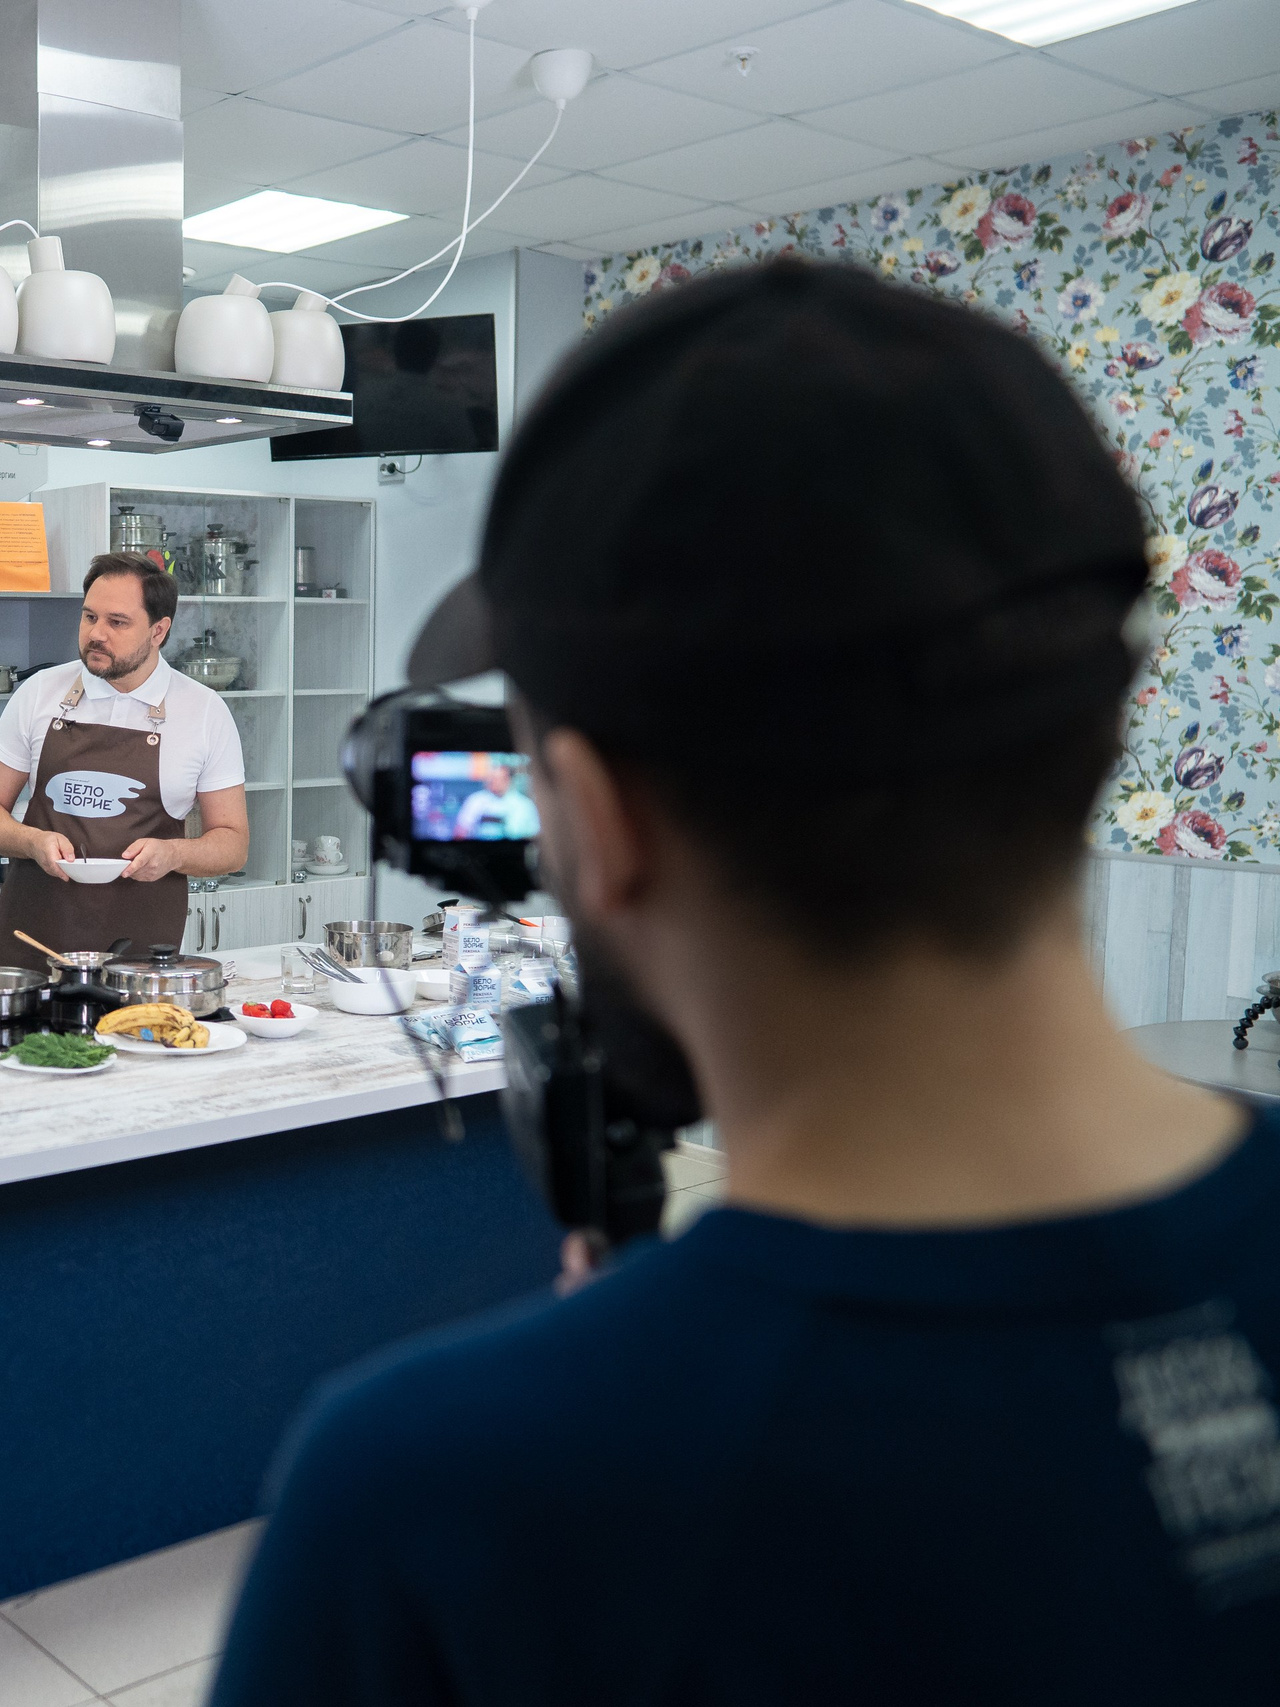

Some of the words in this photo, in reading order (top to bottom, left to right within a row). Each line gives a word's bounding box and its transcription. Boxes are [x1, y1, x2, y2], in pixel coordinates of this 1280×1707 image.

[63, 782, 104, 798] БЕЛО
[63, 793, 113, 811] ЗОРИЕ
[473, 977, 493, 985] БЕЛО
